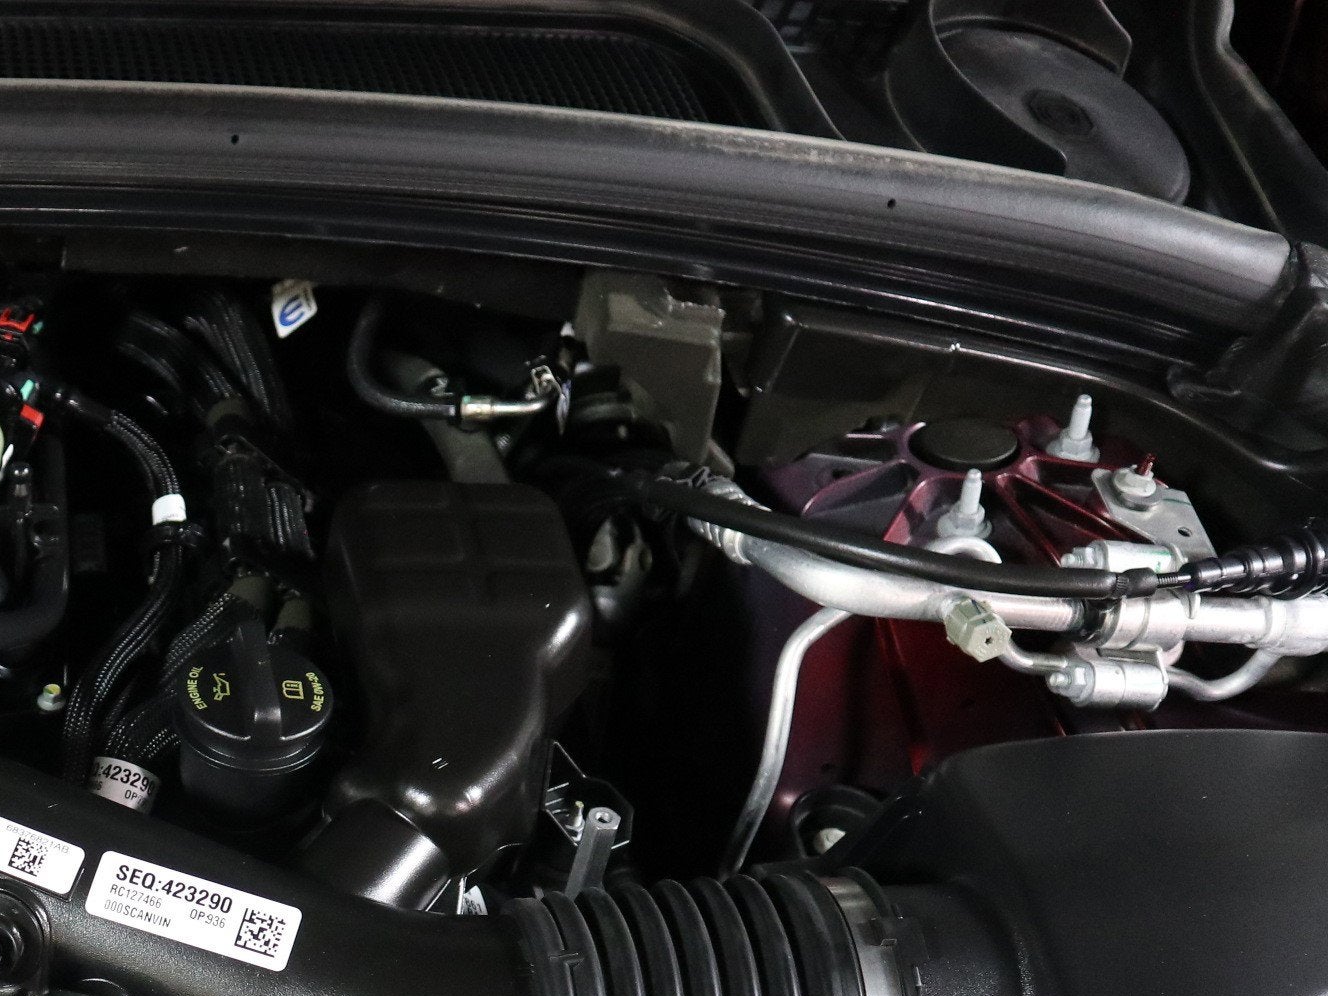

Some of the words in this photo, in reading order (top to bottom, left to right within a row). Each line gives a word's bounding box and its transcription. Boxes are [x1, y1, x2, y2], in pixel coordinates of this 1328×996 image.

[188, 666, 204, 679] OIL
[305, 672, 325, 695] 0W-20
[187, 679, 208, 710] ENGINE
[310, 694, 325, 712] SAE
[109, 883, 163, 909] RC127466
[116, 864, 233, 914] SEQ:423290
[104, 899, 172, 928] 000SCANVIN
